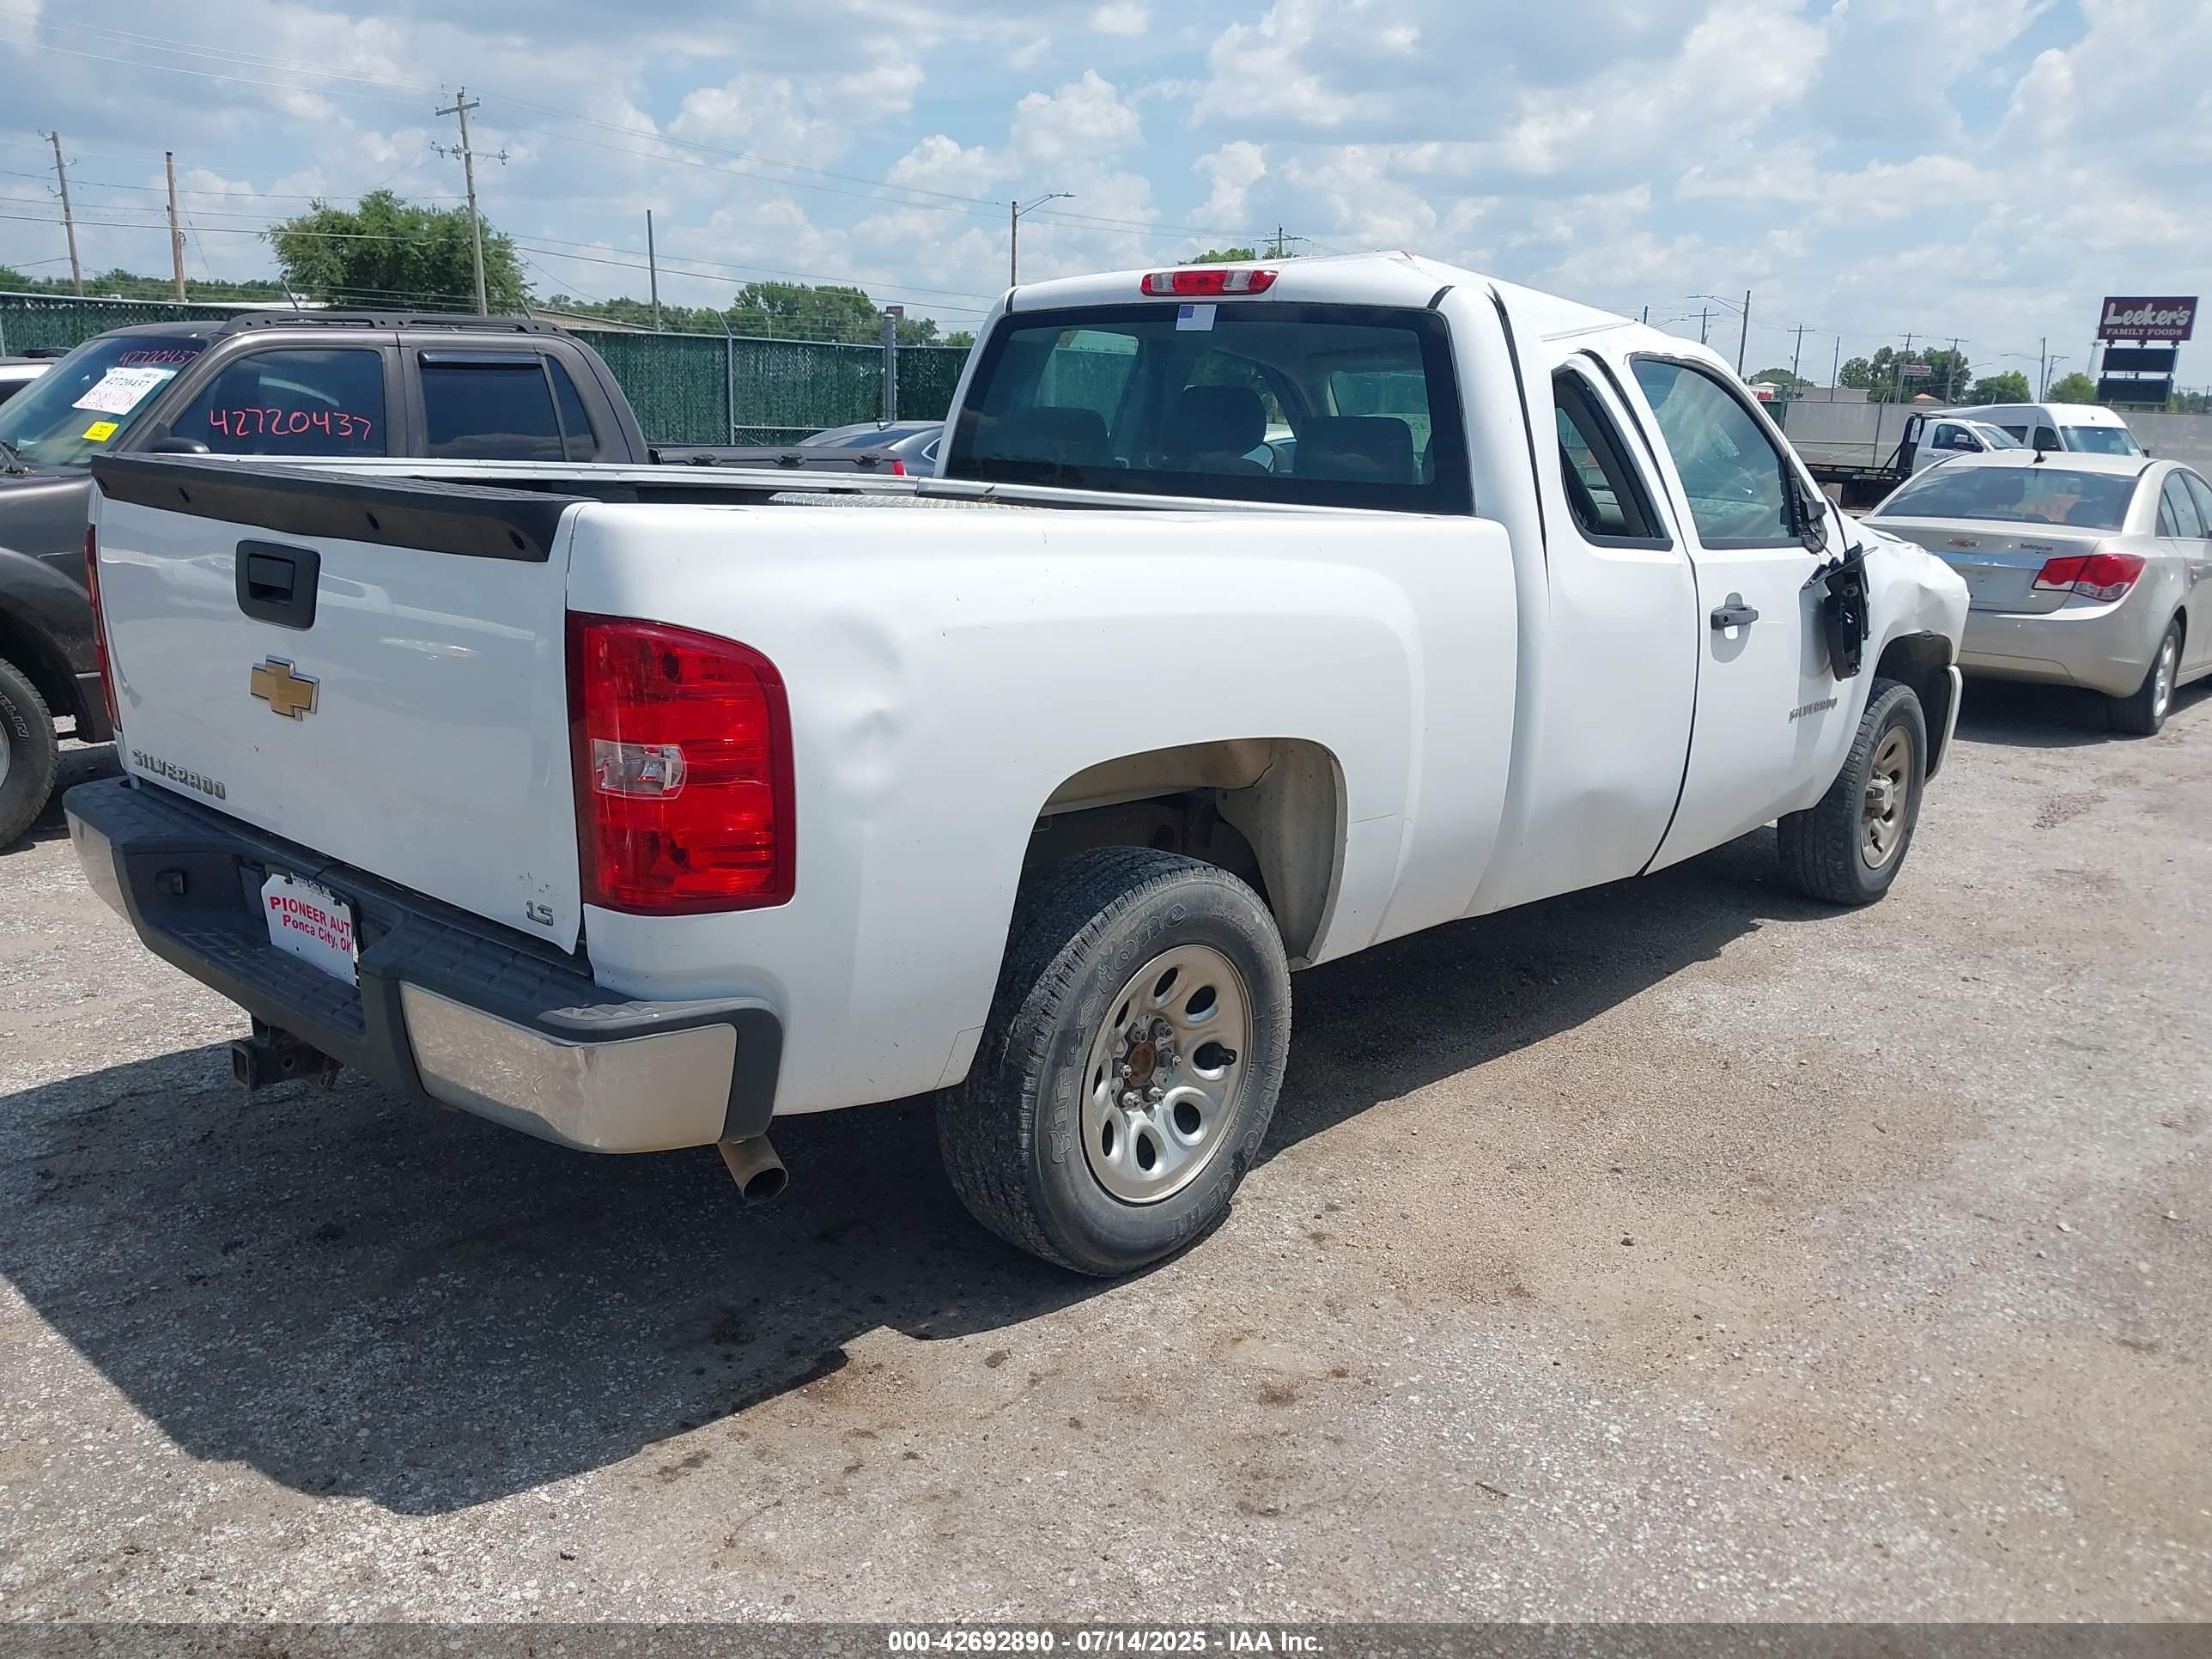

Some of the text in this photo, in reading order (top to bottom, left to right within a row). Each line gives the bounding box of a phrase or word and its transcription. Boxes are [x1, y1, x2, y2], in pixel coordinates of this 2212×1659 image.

[2103, 302, 2191, 325] Leeker's
[118, 349, 199, 366] 42720437
[210, 408, 372, 440] 42720437
[132, 749, 226, 799] SILVERADO
[270, 896, 326, 926] PIONEER
[526, 900, 554, 927] LS
[283, 915, 315, 936] Ponca
[319, 927, 338, 949] City,
[1049, 903, 1187, 1164] Firestone
